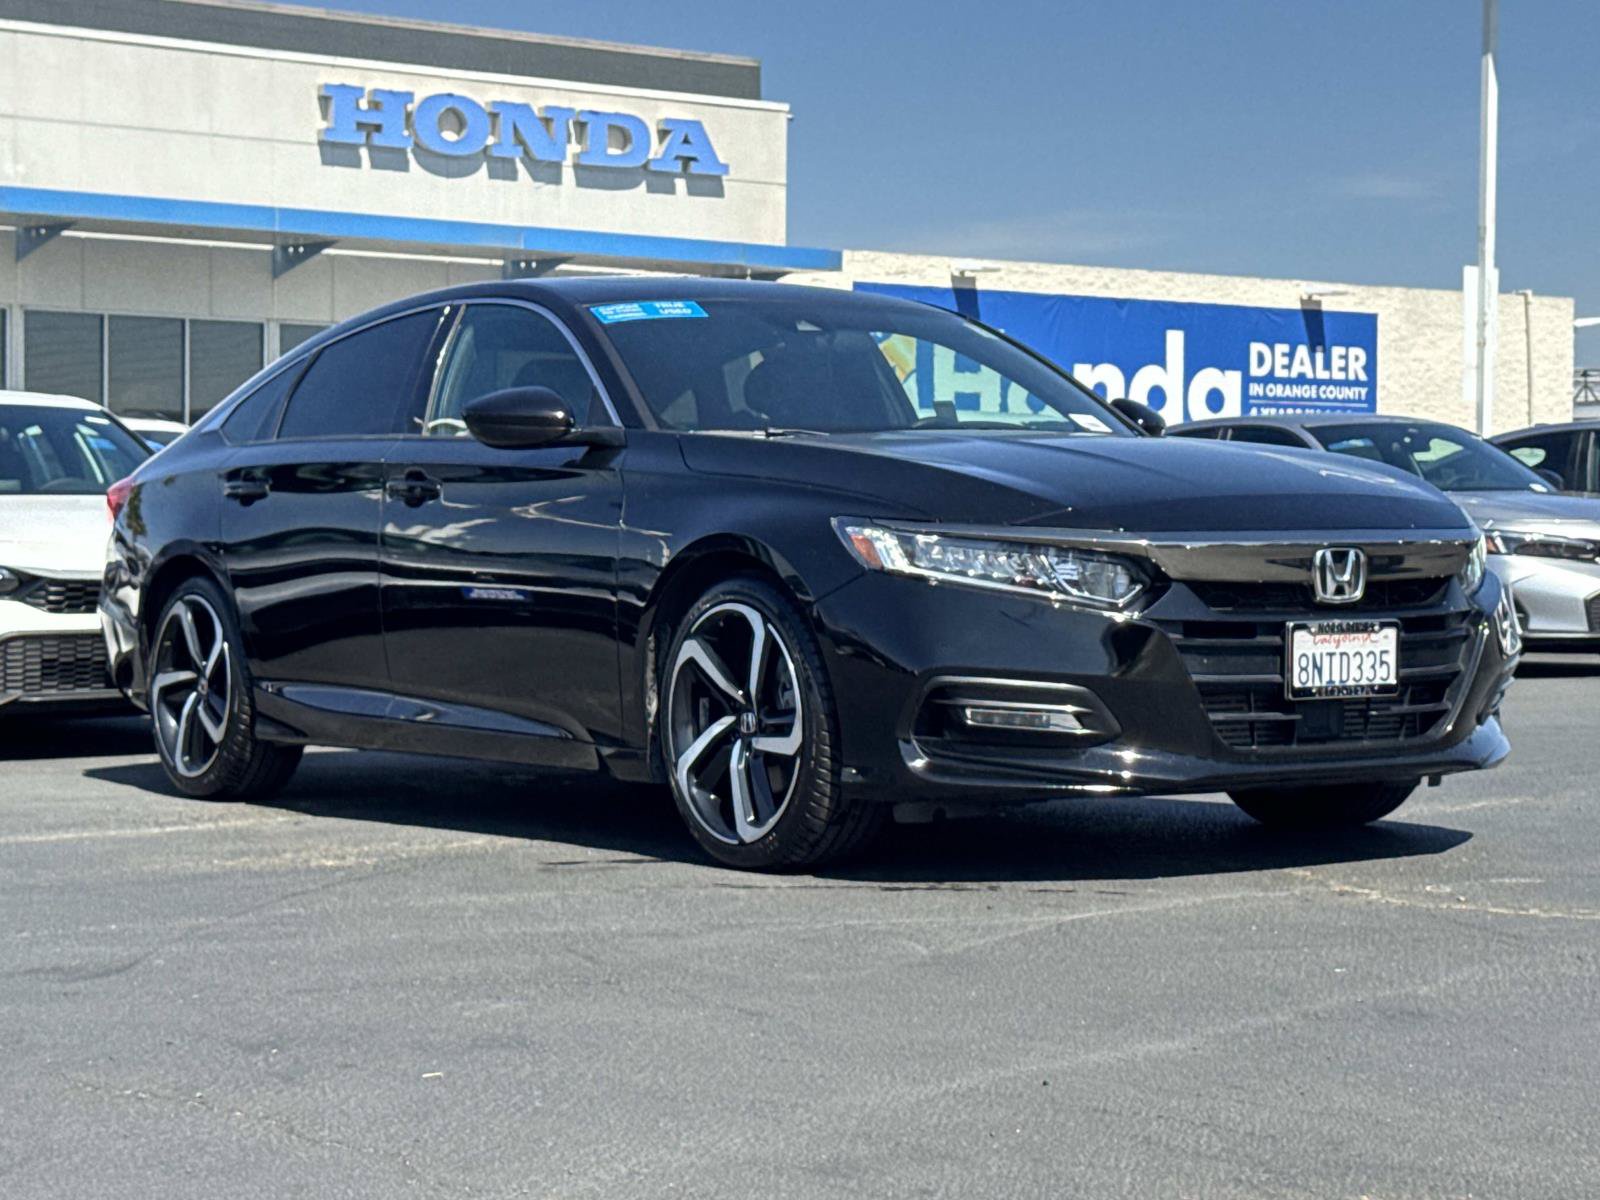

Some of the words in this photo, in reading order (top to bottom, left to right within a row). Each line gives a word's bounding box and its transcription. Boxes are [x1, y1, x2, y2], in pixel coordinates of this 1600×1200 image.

[319, 83, 730, 176] HONDA
[1249, 341, 1369, 382] DEALER
[1249, 382, 1264, 397] IN
[1265, 382, 1318, 399] ORANGE
[1319, 385, 1369, 401] COUNTY
[1298, 650, 1391, 686] 8NID335
